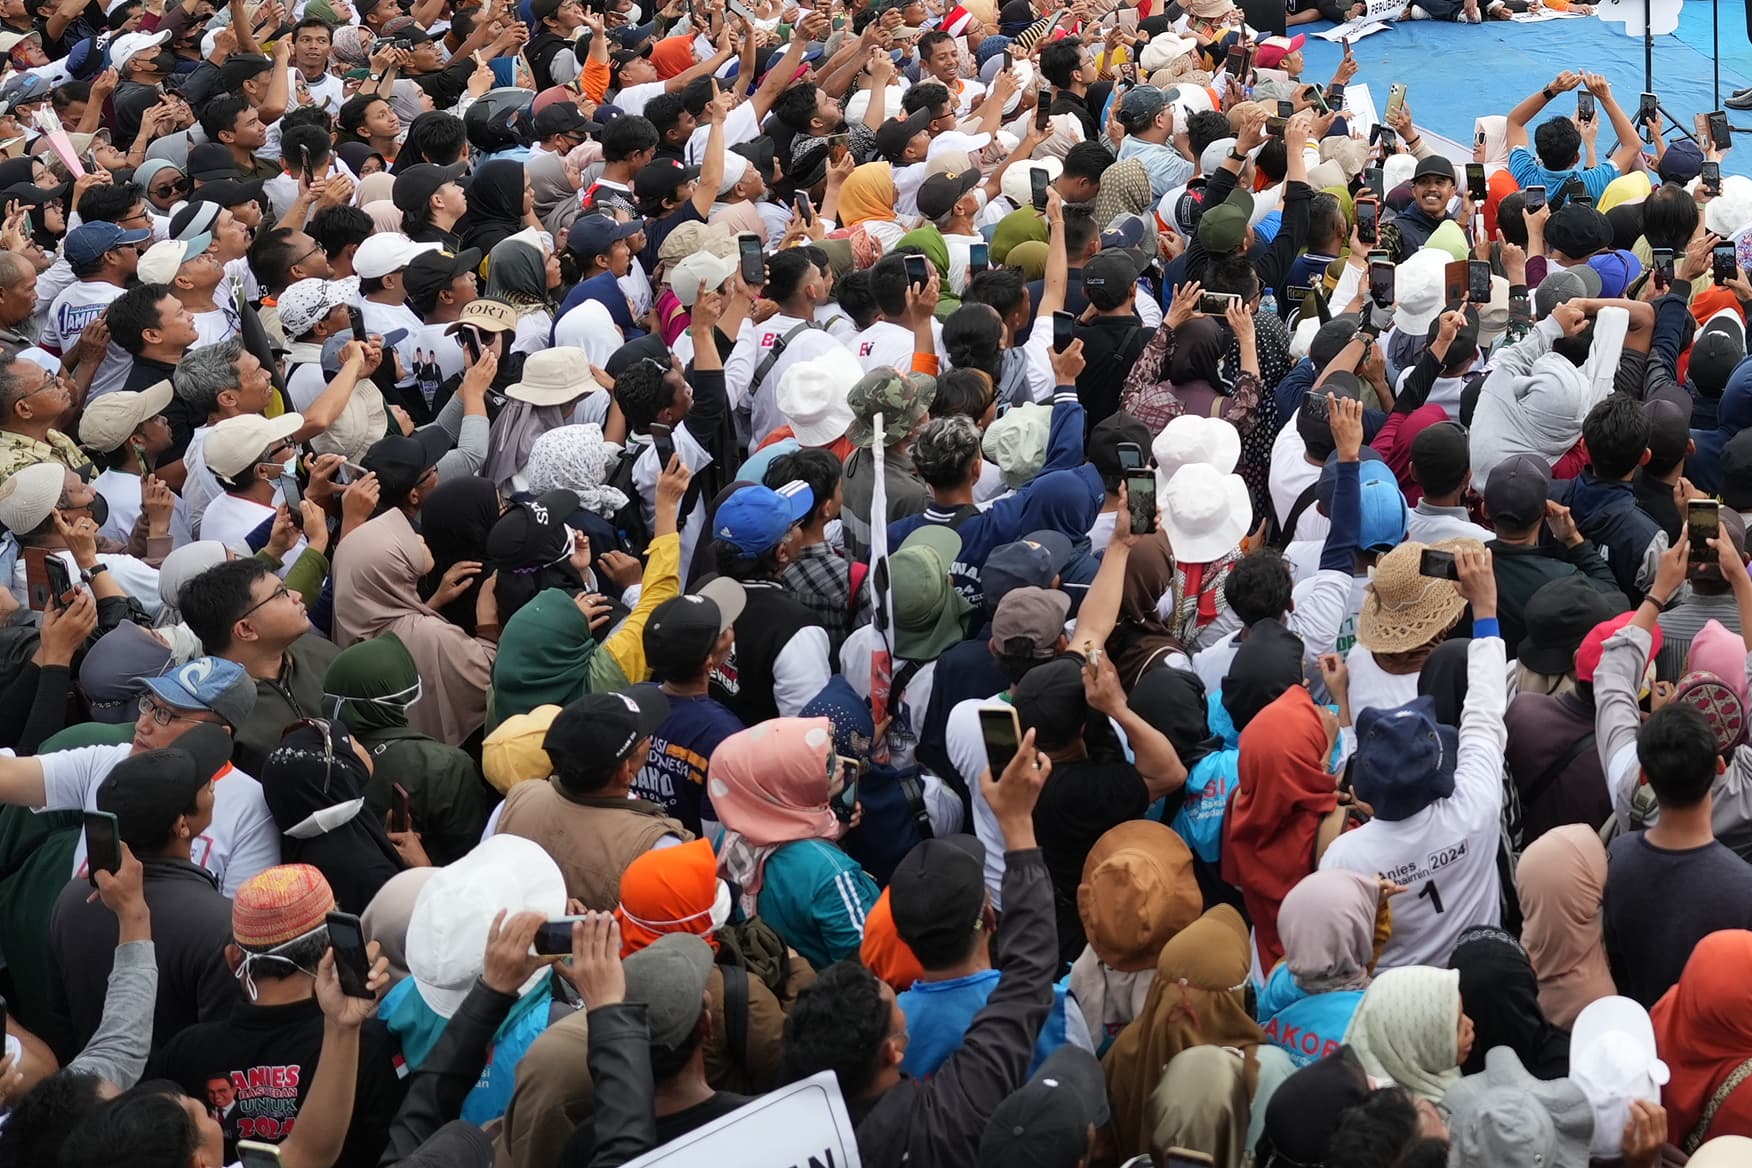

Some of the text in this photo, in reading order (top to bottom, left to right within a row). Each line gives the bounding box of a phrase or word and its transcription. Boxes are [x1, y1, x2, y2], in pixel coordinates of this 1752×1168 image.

[466, 302, 506, 320] PORT
[1430, 843, 1467, 869] 2024
[1393, 868, 1430, 887] haimin
[1418, 880, 1444, 913] 1
[231, 1065, 300, 1090] ANIES
